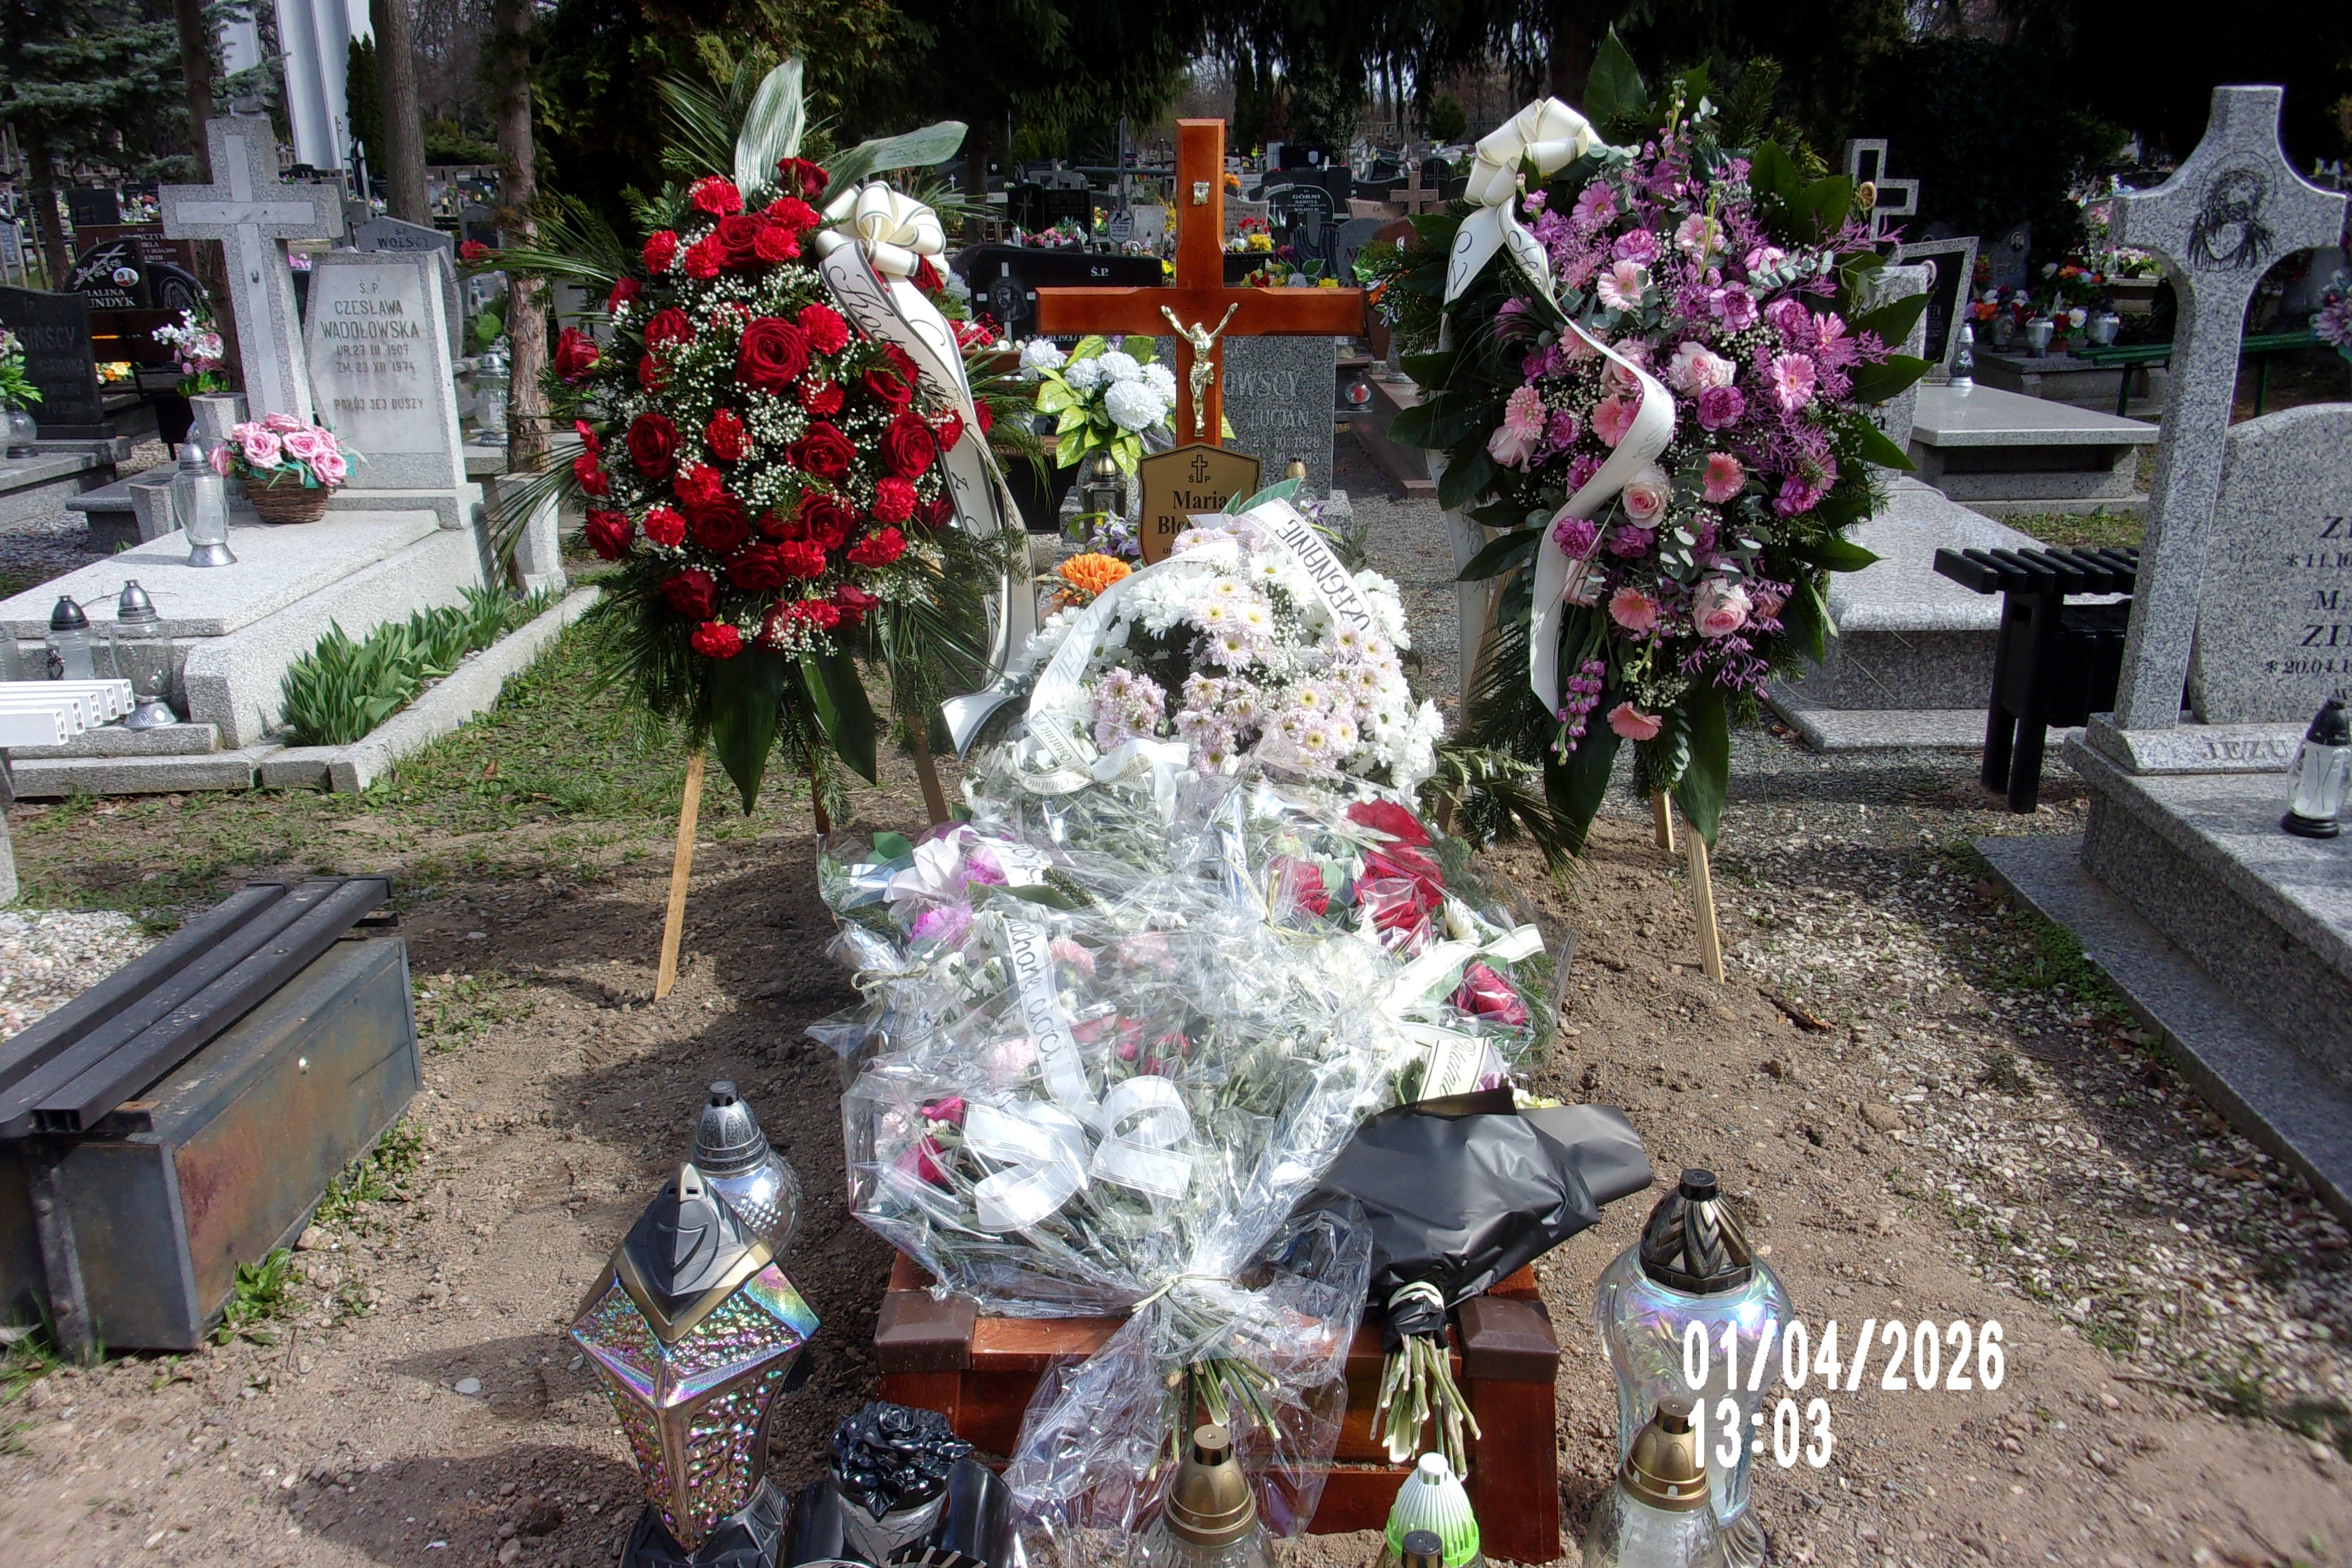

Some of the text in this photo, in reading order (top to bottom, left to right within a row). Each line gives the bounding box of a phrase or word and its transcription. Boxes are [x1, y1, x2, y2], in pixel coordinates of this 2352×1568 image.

[334, 300, 404, 315] CZESŁAWA
[320, 321, 420, 341] WĄDOŁOWSKA
[387, 344, 409, 355] 1907
[333, 396, 424, 410] POKÓJ JEJ DUSZY
[1172, 490, 1228, 509] Maria
[2201, 740, 2289, 761] JEZU
